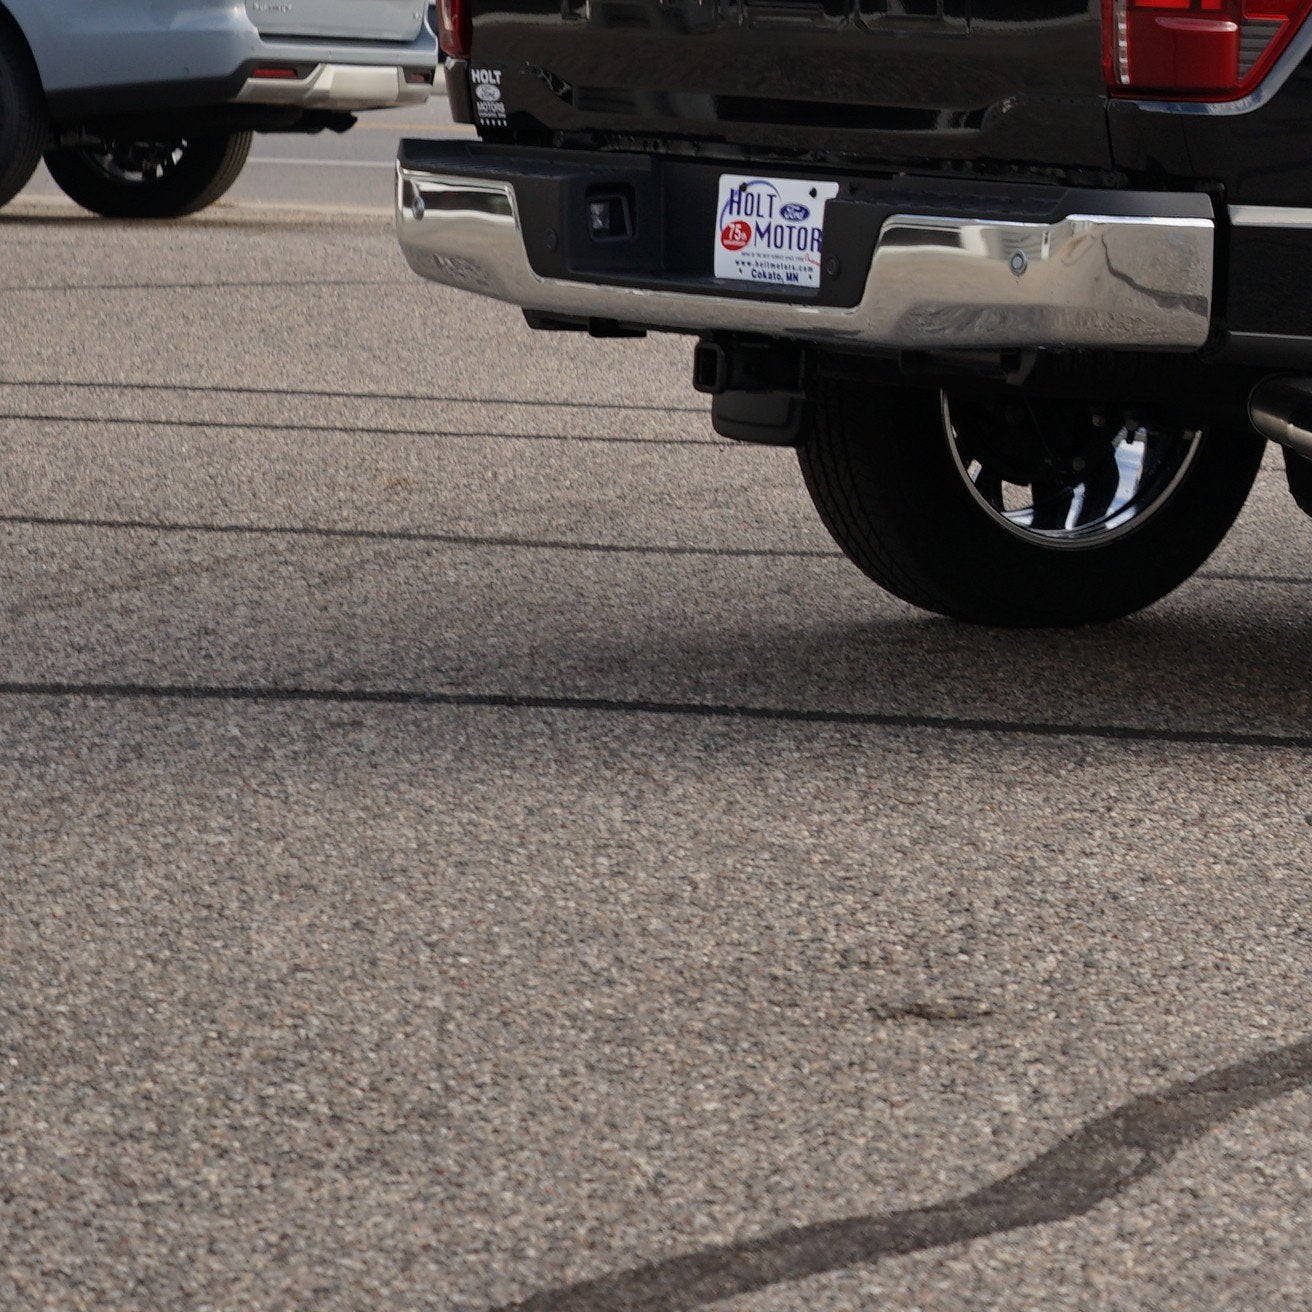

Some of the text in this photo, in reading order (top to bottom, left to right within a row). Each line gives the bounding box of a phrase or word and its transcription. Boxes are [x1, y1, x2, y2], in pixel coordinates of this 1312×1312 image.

[471, 69, 502, 84] HOLT
[477, 102, 506, 113] MOTORS
[728, 188, 777, 218] HOLT
[751, 269, 800, 283] Cokato, MN
